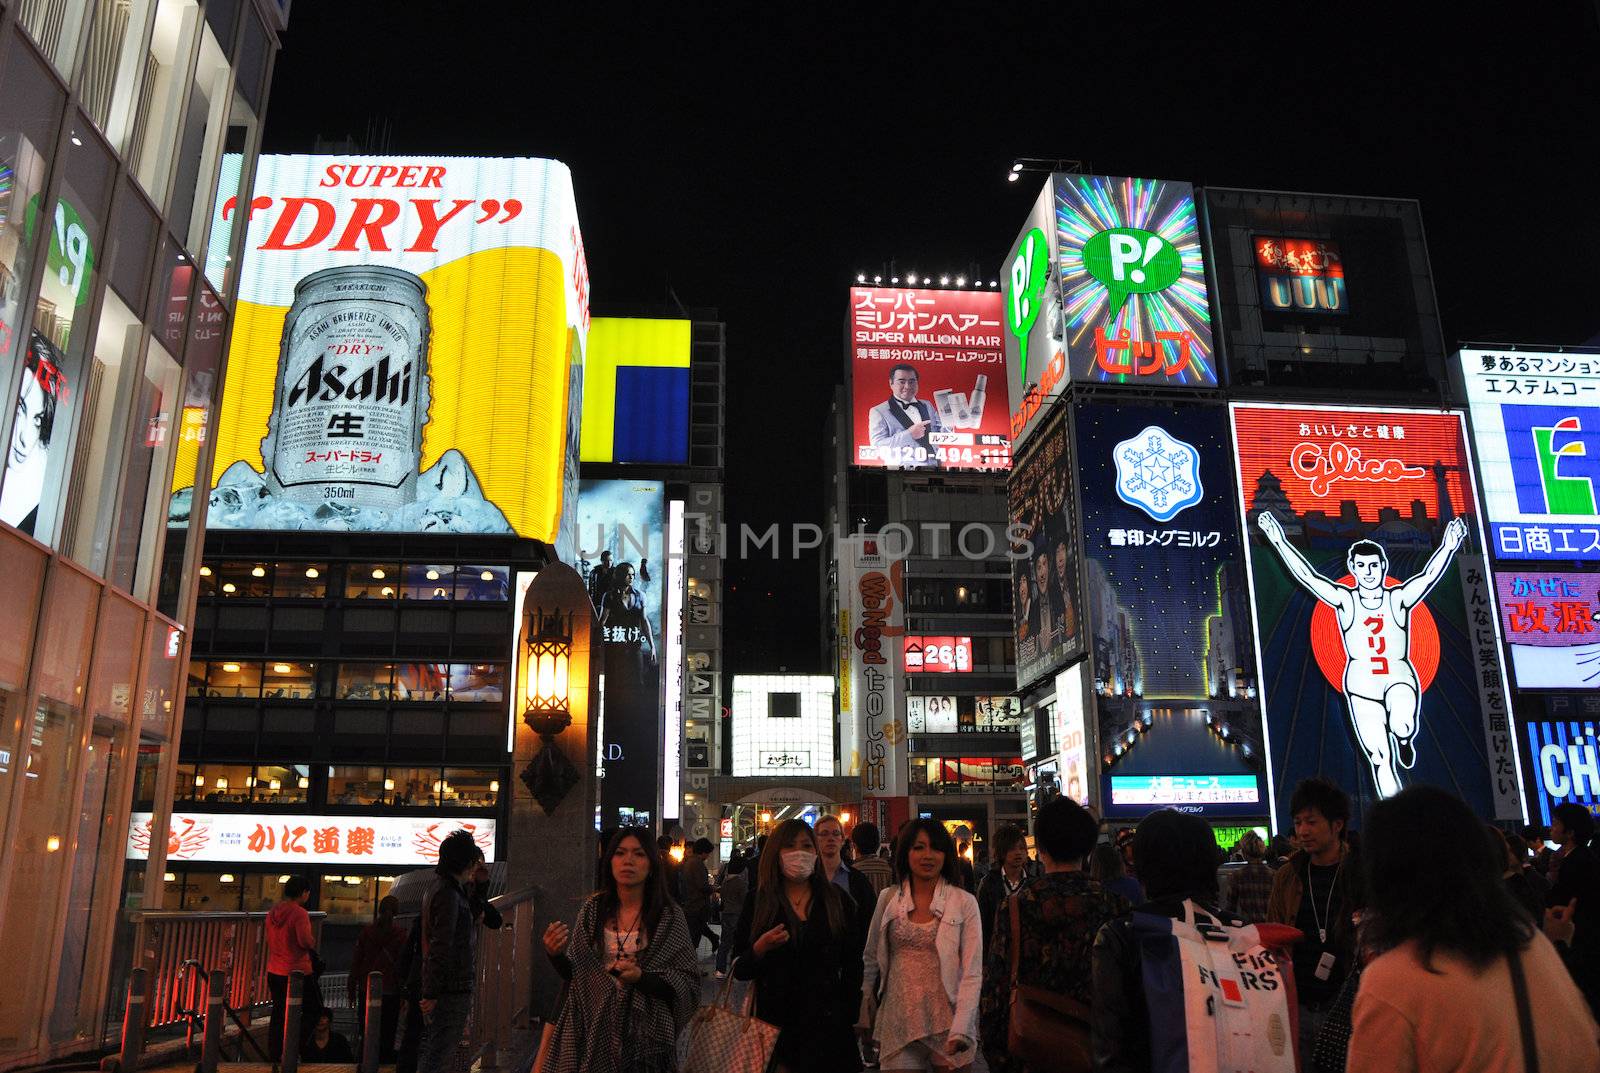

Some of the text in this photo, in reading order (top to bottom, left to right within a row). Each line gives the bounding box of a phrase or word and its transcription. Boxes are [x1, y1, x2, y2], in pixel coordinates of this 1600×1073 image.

[319, 164, 447, 188] SUPER
[1109, 233, 1164, 284] P!
[855, 292, 935, 310] スーパー
[332, 311, 377, 325] BREWERIES
[378, 318, 402, 342] LIMITED
[855, 310, 1000, 332] ミリオンヘアー
[856, 332, 1000, 346] SUPER MILLION HAIR
[1095, 326, 1194, 376] ピップ
[288, 353, 412, 407] Asahi
[327, 412, 364, 438] 生
[1299, 422, 1406, 440] おいしさと健康
[305, 449, 383, 465] スーパードライ
[1290, 441, 1426, 498] Glico
[324, 487, 355, 499] 350ml
[1107, 528, 1221, 550] 雪印メグミルク
[1511, 577, 1581, 597] かぜに
[1505, 601, 1595, 634] 改源
[1363, 613, 1390, 675] グリコ
[692, 652, 711, 744] GAME
[1466, 568, 1519, 805] みんなに笑顔を届けたい。
